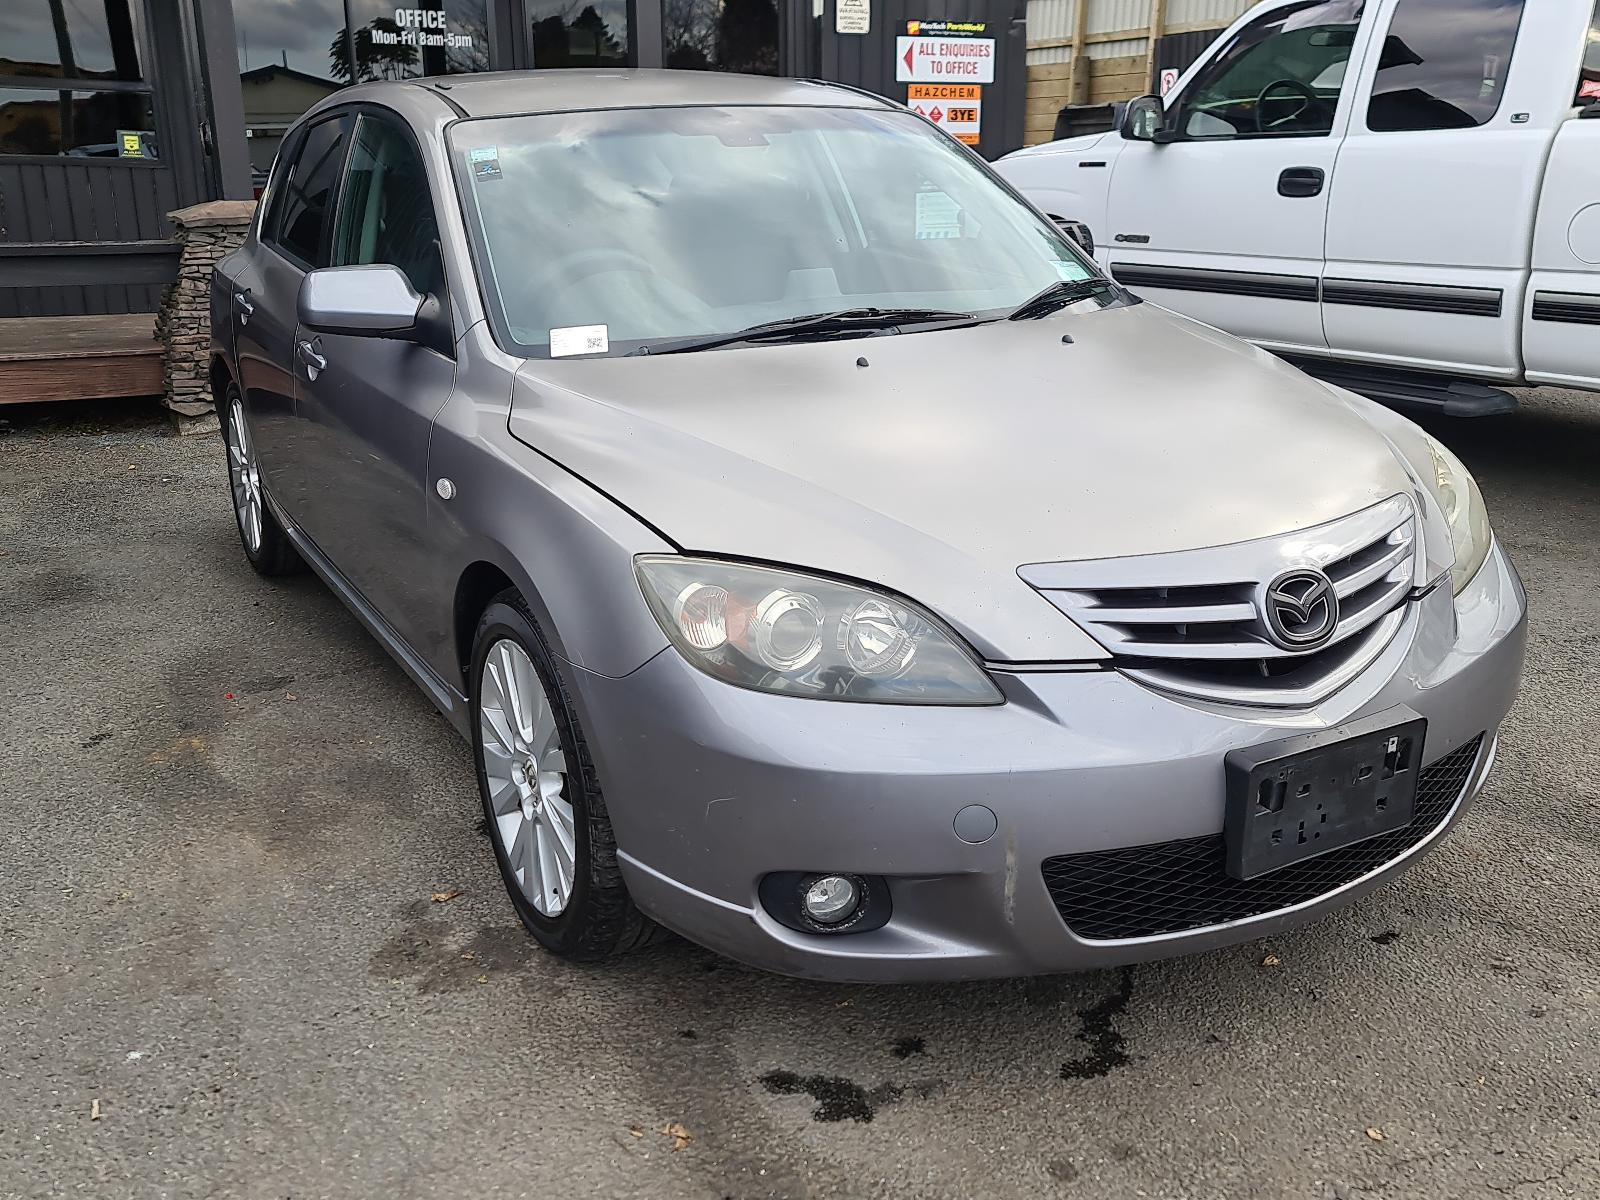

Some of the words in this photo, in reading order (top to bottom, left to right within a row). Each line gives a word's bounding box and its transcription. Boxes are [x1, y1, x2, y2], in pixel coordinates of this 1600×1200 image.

[395, 8, 447, 29] OFFICE
[371, 29, 416, 45] Mon-Fri
[419, 31, 473, 48] 8am-5pm
[918, 42, 937, 56] ALL
[939, 43, 991, 58] ENQUIRIES
[930, 60, 943, 74] TO
[945, 61, 979, 75] OFFICE
[914, 87, 975, 98] HAZCHEM
[950, 109, 975, 121] 3YE
